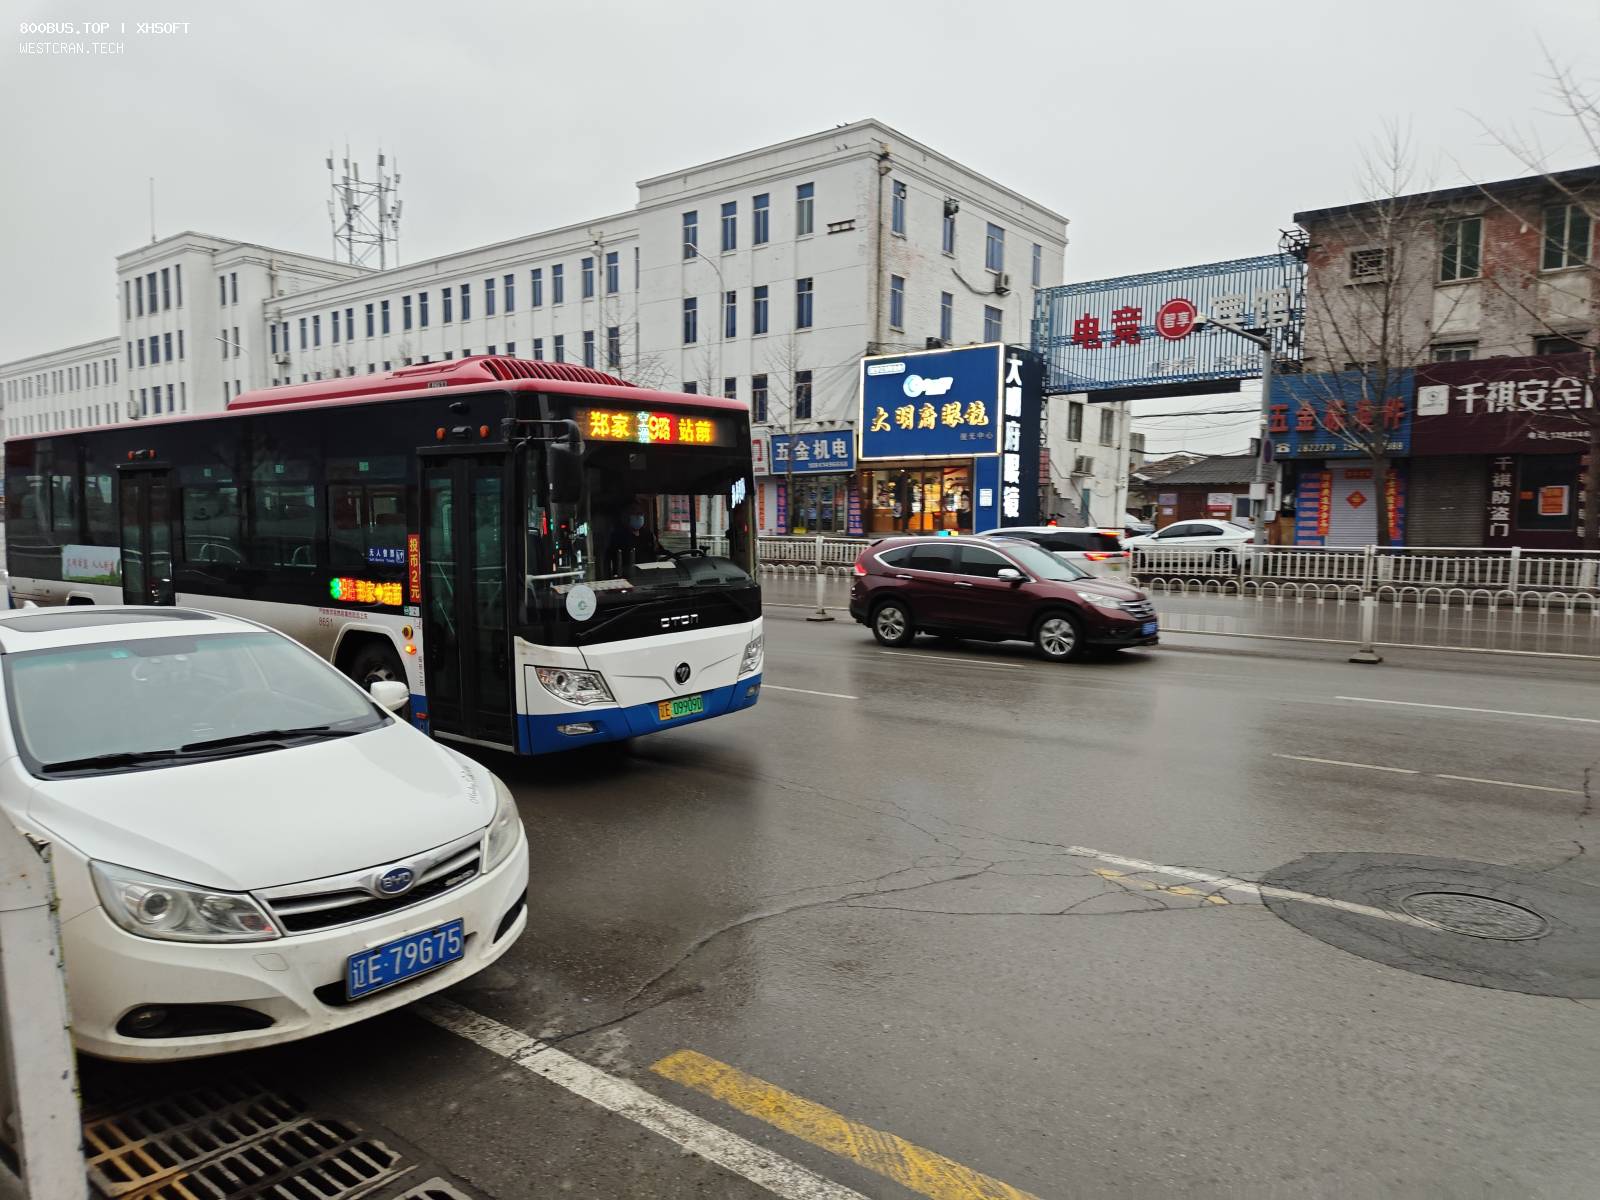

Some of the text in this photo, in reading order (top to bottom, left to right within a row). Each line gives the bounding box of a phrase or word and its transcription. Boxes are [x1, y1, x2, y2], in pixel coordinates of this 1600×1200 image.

[1072, 305, 1142, 350] 电竞
[590, 410, 630, 438] 郑家
[678, 418, 714, 442] 站前
[870, 400, 989, 432] 大明府眼镜
[775, 438, 849, 461] 五金机电
[408, 538, 420, 599] 投币2元
[382, 871, 411, 887] BYD
